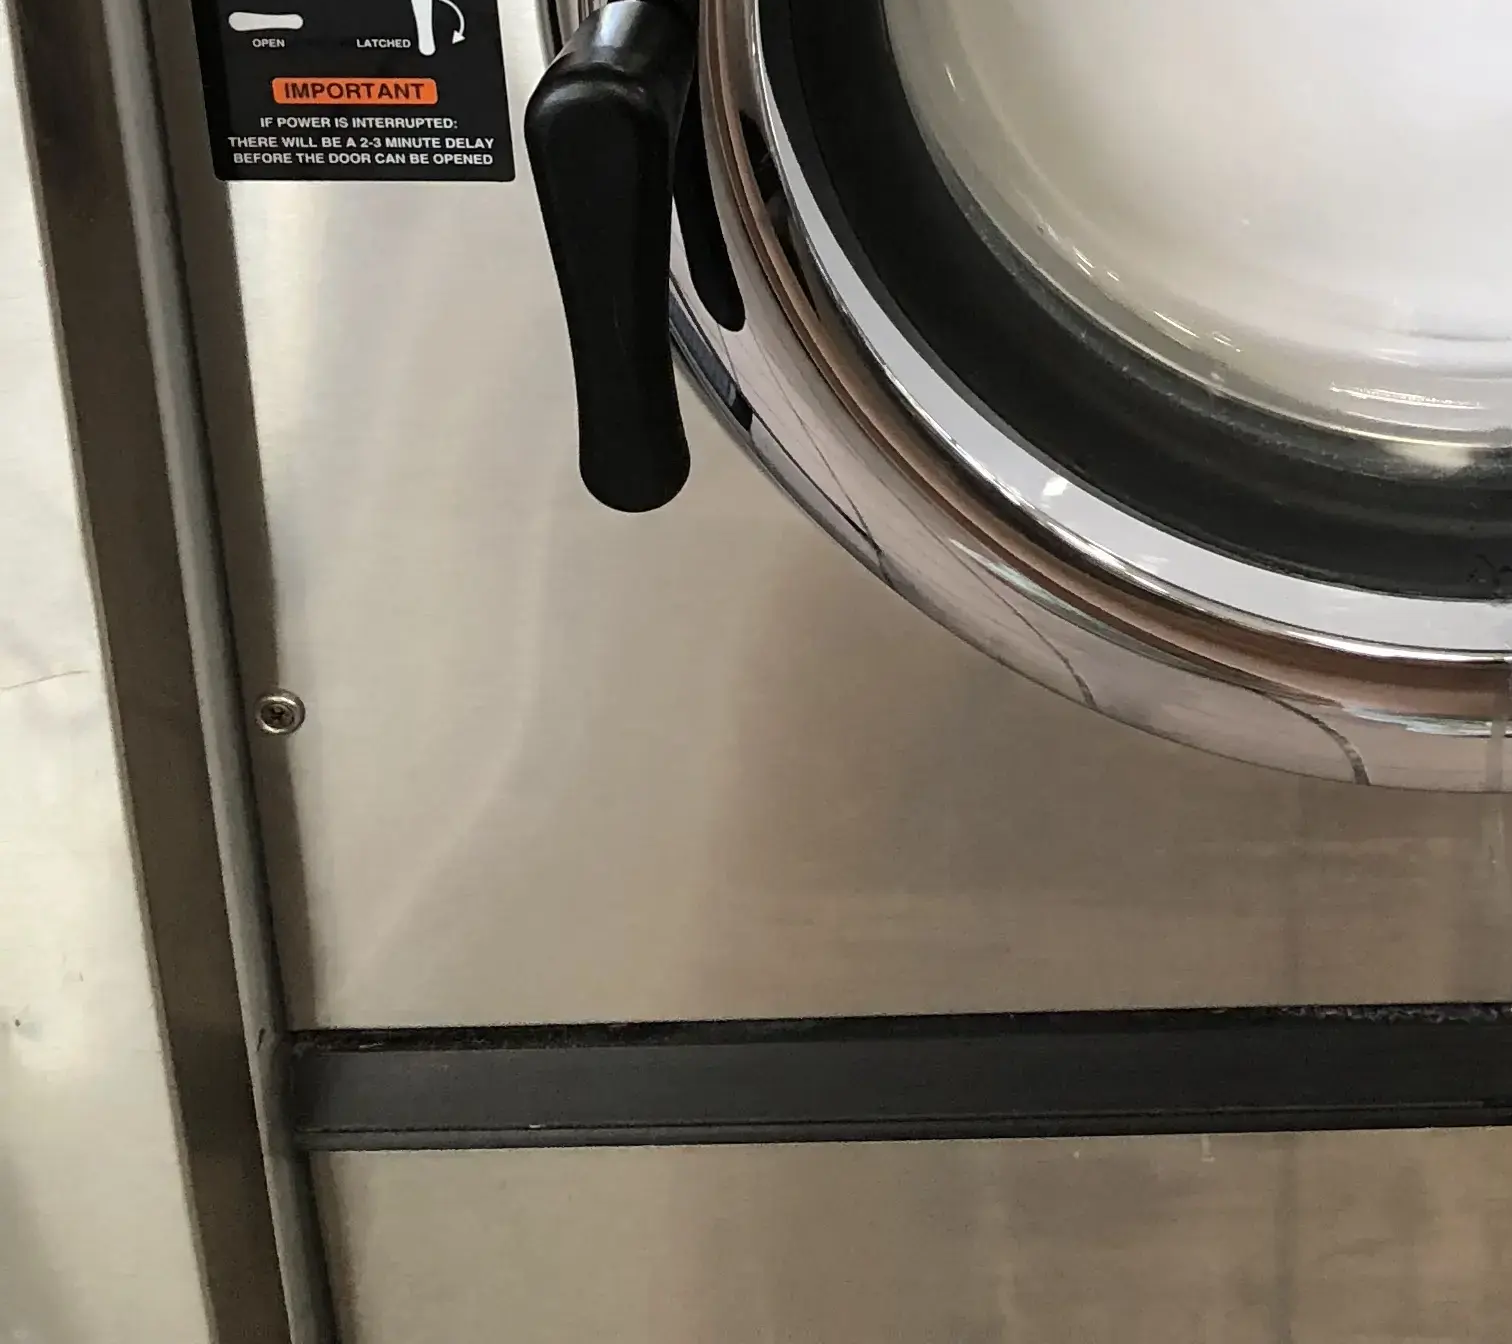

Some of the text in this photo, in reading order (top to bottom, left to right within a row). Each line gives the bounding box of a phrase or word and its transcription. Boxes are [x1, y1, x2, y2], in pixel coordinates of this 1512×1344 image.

[253, 39, 285, 48] OPEN
[357, 39, 411, 48] LATCHED
[284, 83, 424, 99] IMPORTANT
[260, 118, 457, 129] IF POWER IS INTERRUPTED:
[228, 137, 494, 149] THERE WILL BE A 2-3 MINUTE DELAY
[234, 154, 492, 164] BEFORE THE DOOR CAN BE OPENED
